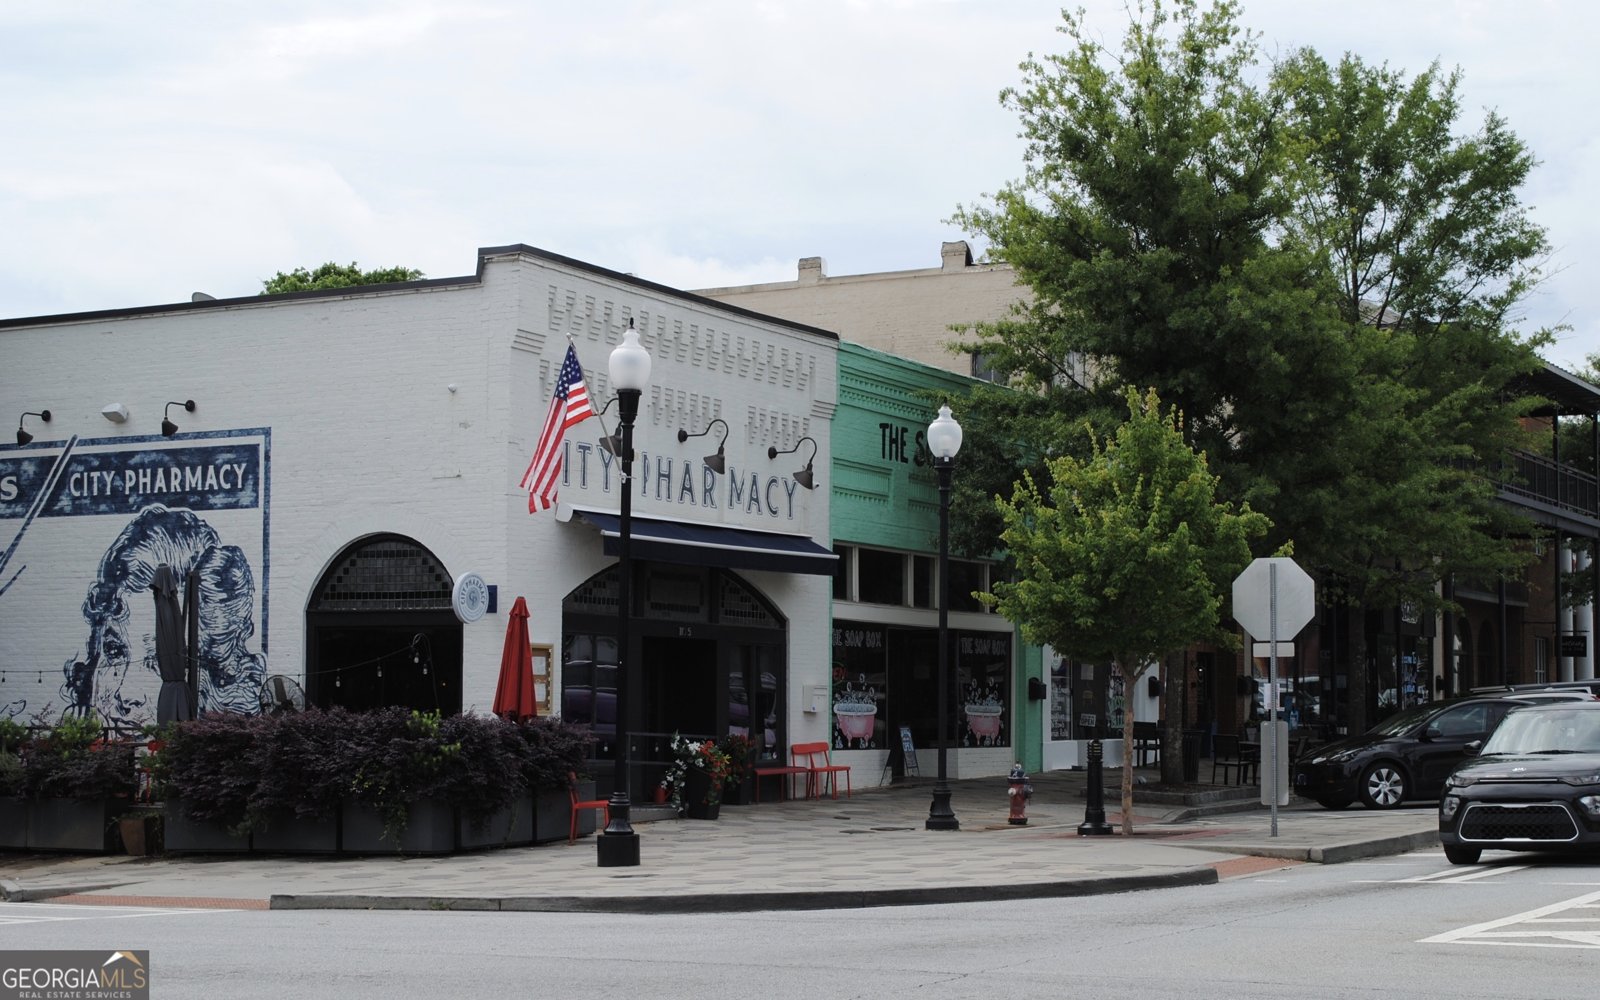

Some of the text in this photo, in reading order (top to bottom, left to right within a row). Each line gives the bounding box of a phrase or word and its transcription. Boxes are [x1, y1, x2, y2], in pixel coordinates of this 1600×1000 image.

[879, 423, 908, 464] THE
[69, 463, 247, 497] CITY PHARMACY
[562, 439, 798, 520] ITY PHARMACY
[465, 578, 486, 605] PHARMACY
[865, 630, 882, 648] BOX
[960, 637, 974, 655] THE
